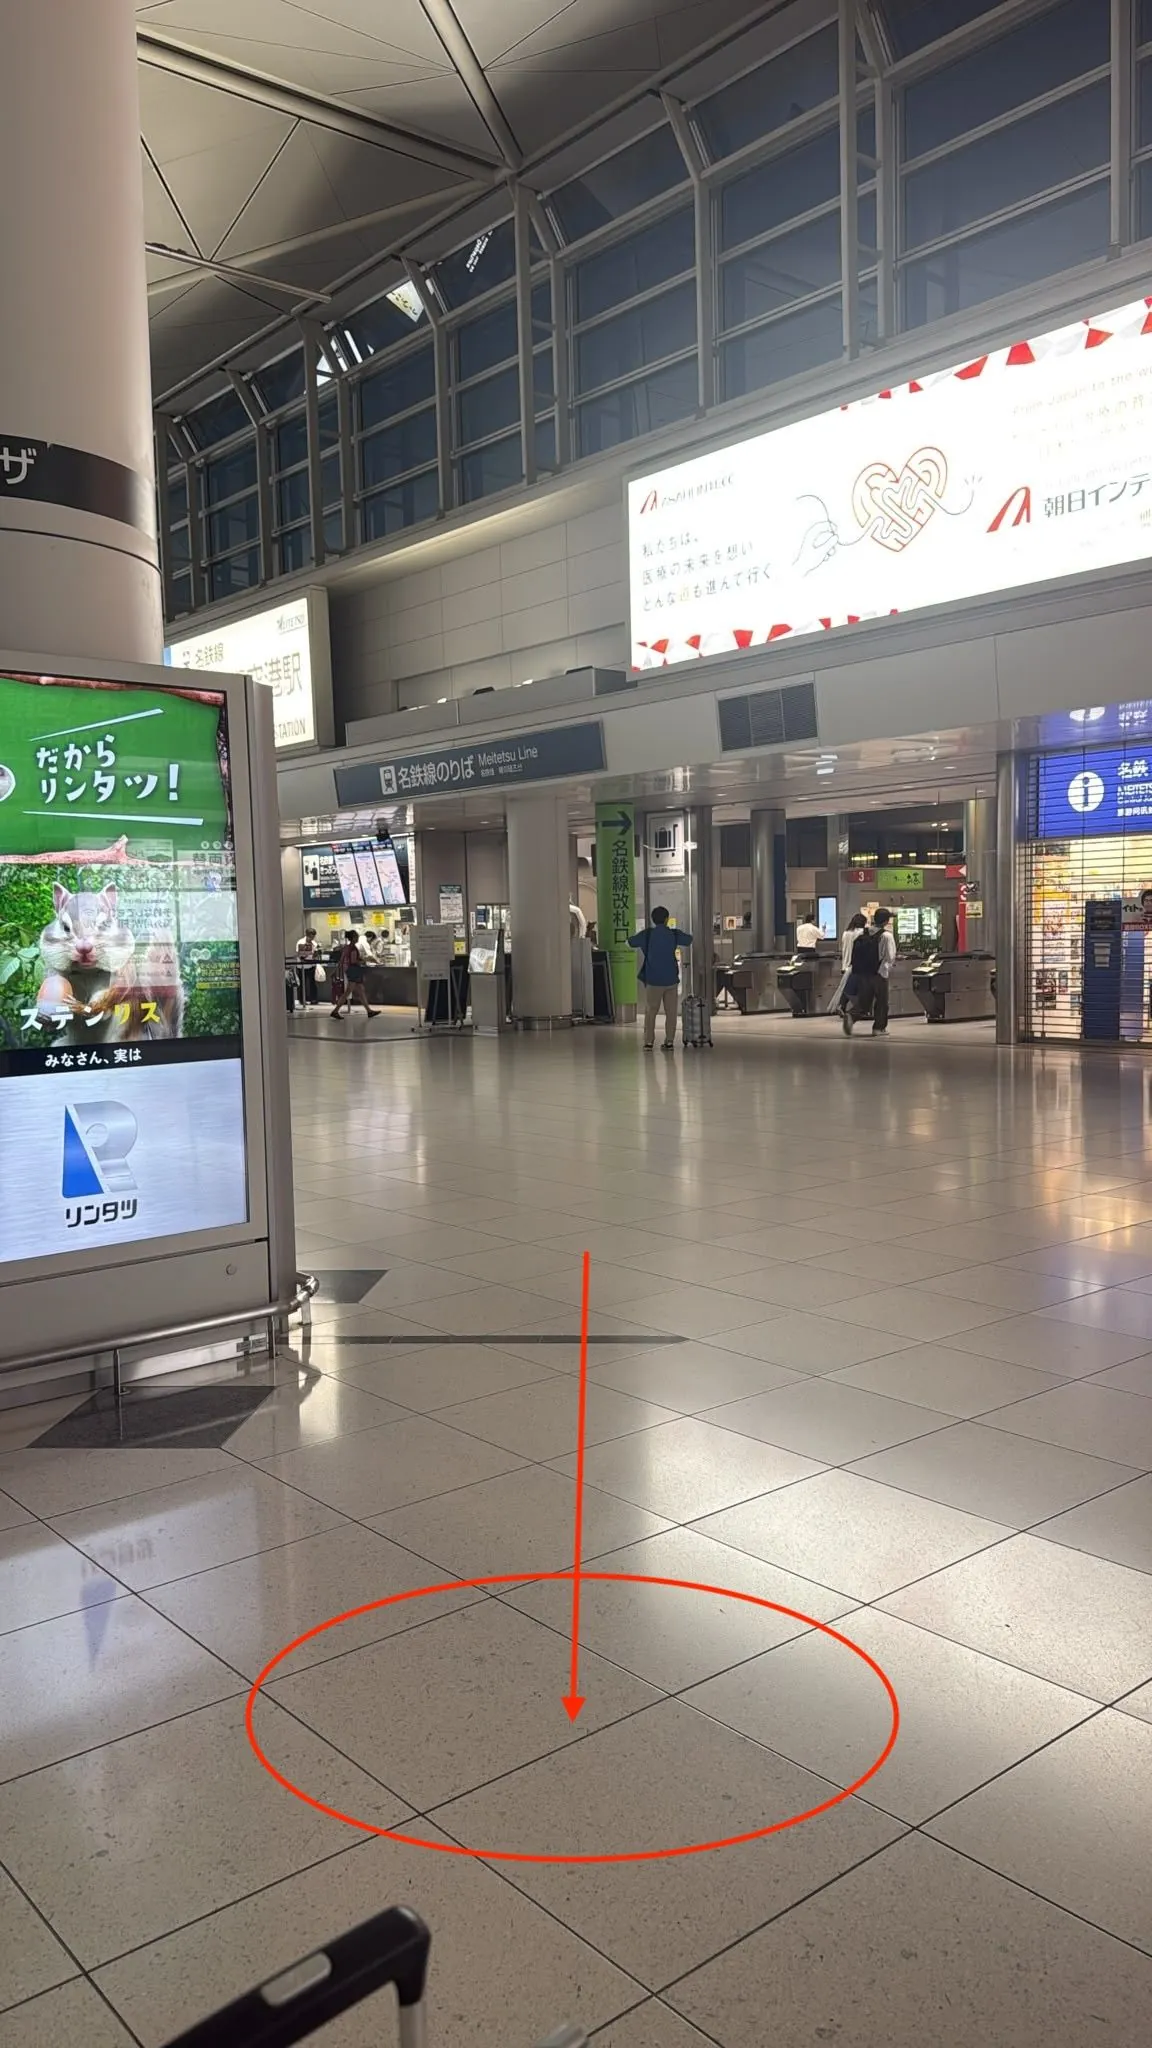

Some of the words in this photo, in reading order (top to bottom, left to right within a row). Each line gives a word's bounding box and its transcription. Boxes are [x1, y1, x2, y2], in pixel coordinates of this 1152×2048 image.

[1043, 473, 1152, 518] 朝日インテ
[36, 734, 116, 774] だから
[478, 750, 516, 767] Meitetsu
[517, 745, 539, 760] Line
[398, 755, 475, 789] 名鉄線のりば
[611, 839, 630, 945] 名鉄線改札口
[20, 1002, 161, 1031] ステンリス
[45, 1048, 142, 1068] みなさん、実は
[65, 1199, 138, 1229] リンタツ
